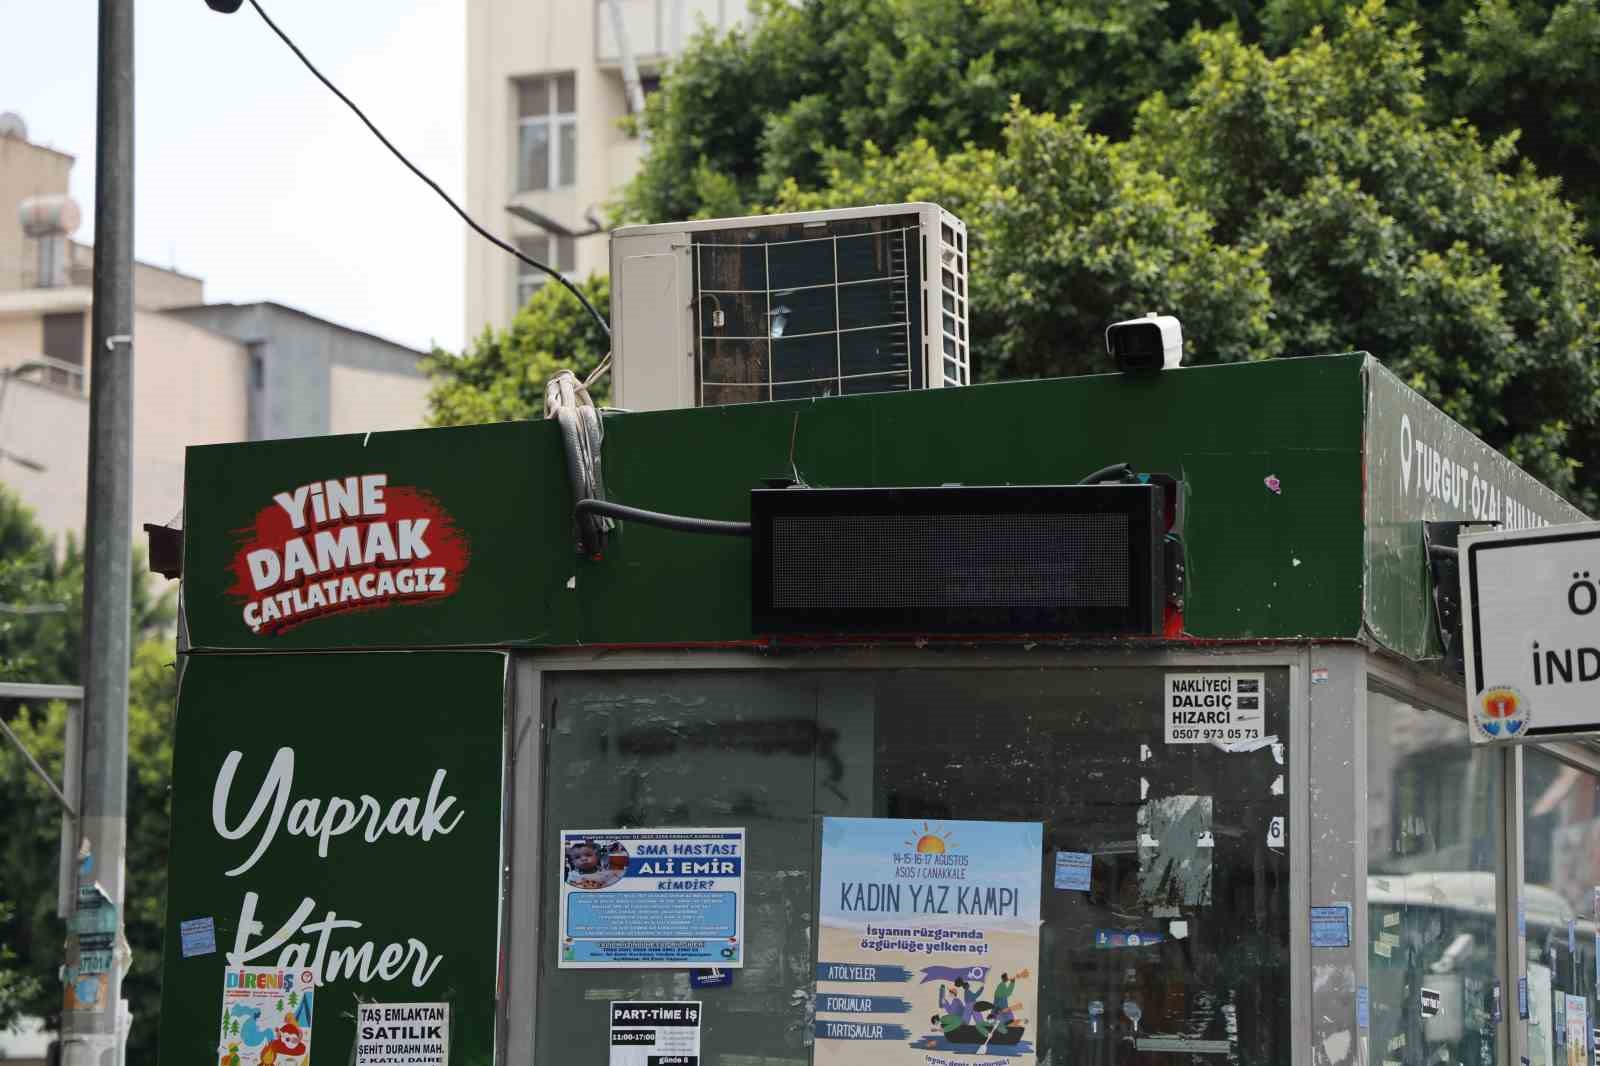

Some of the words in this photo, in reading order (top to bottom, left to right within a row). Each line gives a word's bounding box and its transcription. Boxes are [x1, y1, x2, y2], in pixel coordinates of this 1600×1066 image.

[1415, 439, 1469, 513] TURGUT
[246, 518, 432, 592] DAMAK
[242, 566, 447, 633] ÇATLATACAGIZ
[1568, 571, 1600, 616] Ö
[1532, 640, 1600, 686] İND
[1172, 676, 1231, 692] NAKLİYECİ
[1172, 695, 1232, 710] DALGIÇ
[1172, 729, 1200, 739] 0507
[1203, 729, 1224, 739] 973
[1227, 729, 1241, 739] 05
[1245, 729, 1259, 739] 73
[212, 747, 465, 876] Yaprak
[637, 843, 668, 855] SMA
[673, 842, 738, 855] HASTASI
[639, 858, 674, 874] ALİ
[681, 858, 735, 874] EMİR
[840, 882, 900, 912] KADIN
[909, 884, 949, 914] YAZ
[957, 886, 1019, 917] KAMPI
[225, 891, 444, 988] Katmer
[912, 925, 983, 940] rüzgarında
[926, 940, 967, 954] yelken
[968, 943, 988, 955] aç!
[226, 970, 294, 992] DİRENİŞ
[826, 998, 872, 1012] FORUMLAR
[361, 1008, 381, 1024] TAŞ
[385, 1007, 444, 1021] EMLAKTAN
[614, 1007, 682, 1020] PART-TİME
[685, 1007, 698, 1023] İŞ
[361, 1026, 442, 1039] SATILIK
[358, 1042, 384, 1057] ŞEHİT
[422, 1043, 444, 1055] MAH.
